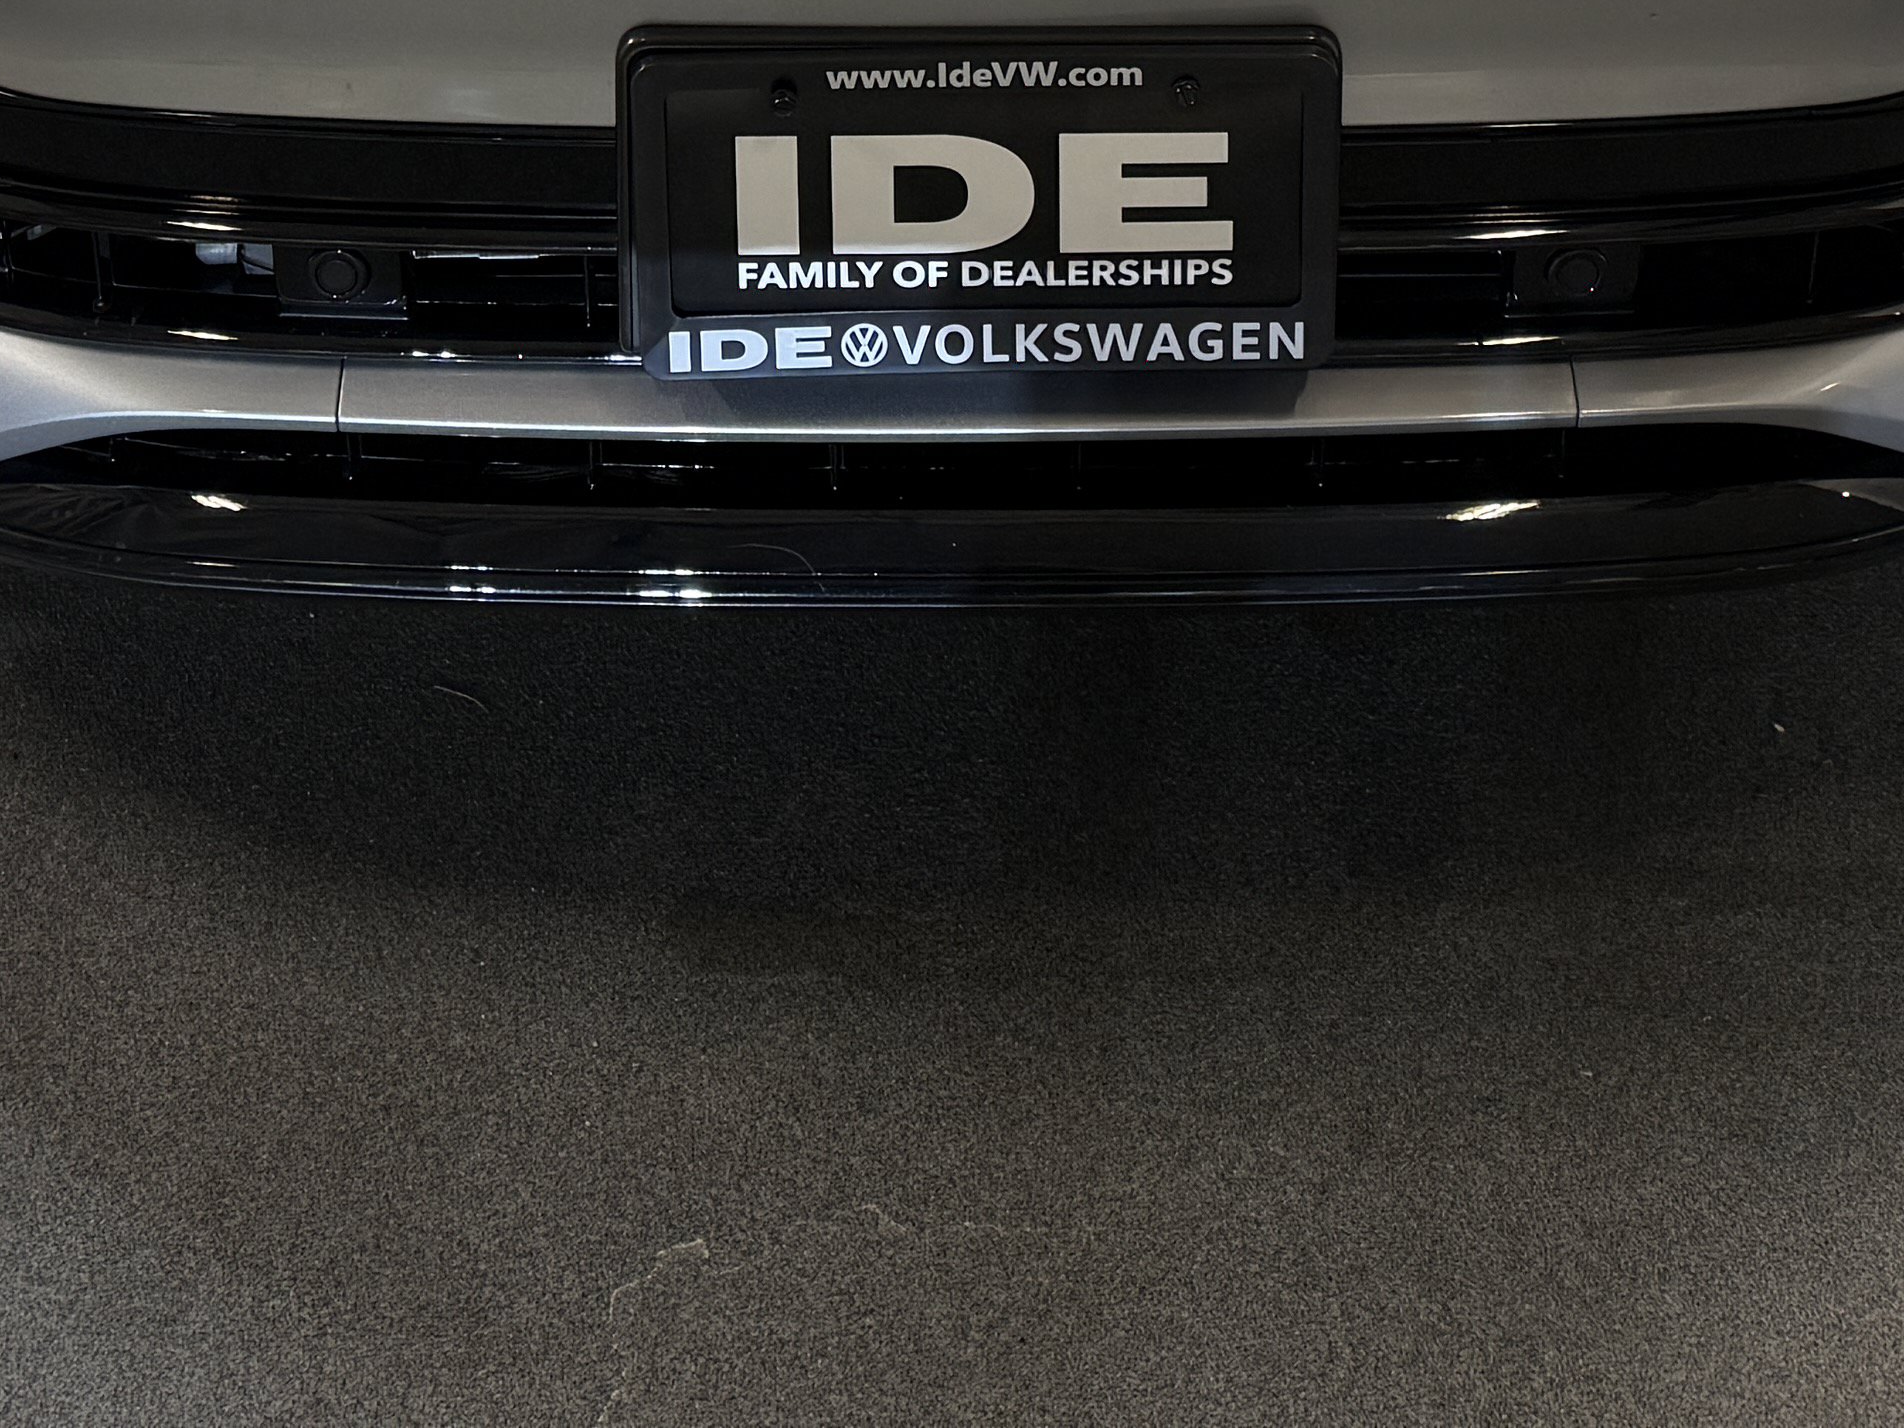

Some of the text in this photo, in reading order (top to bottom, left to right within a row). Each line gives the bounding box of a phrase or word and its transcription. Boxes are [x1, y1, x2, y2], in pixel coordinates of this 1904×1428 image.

[826, 61, 1144, 90] www.IdeVW.com
[734, 131, 1234, 256] IDE
[738, 258, 1233, 290] FAMILY OF DEALERSHIPS
[668, 325, 833, 373] IDE
[893, 321, 1305, 365] VOLKSWAGEN
